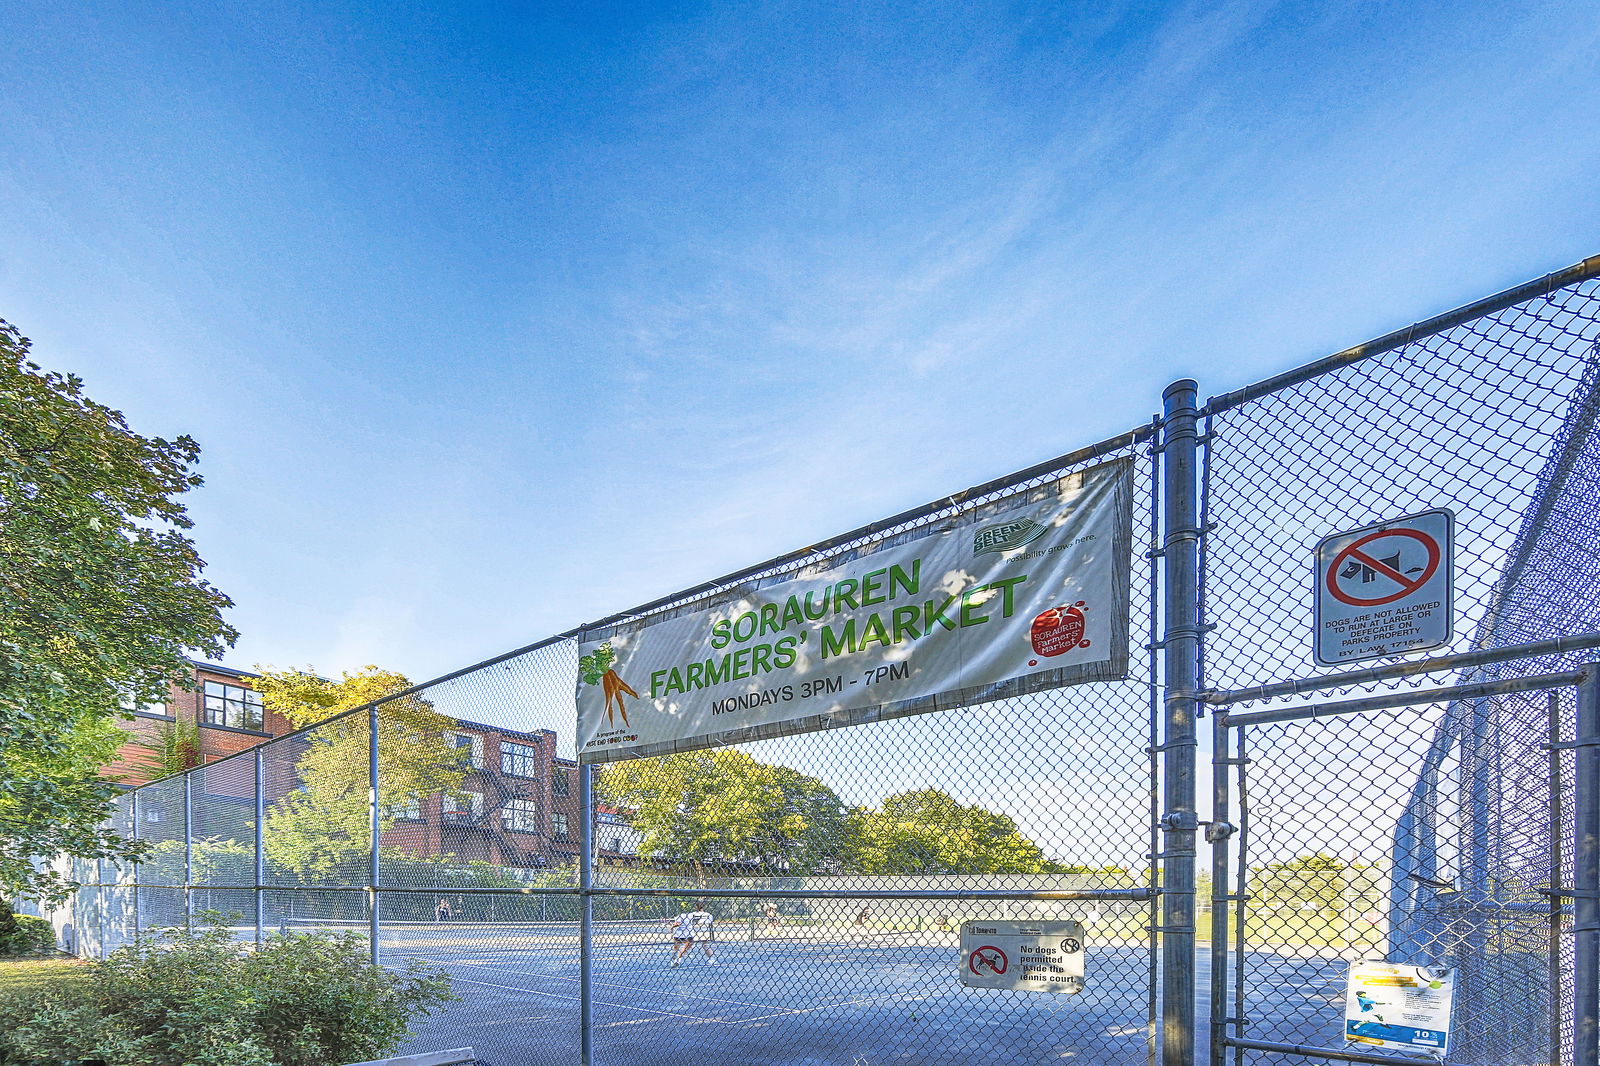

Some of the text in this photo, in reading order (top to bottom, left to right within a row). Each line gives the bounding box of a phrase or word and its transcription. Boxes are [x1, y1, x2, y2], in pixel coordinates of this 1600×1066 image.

[974, 523, 1022, 544] GREEN
[1075, 534, 1097, 545] here.
[973, 534, 1010, 553] BELT
[711, 558, 921, 650] SORAUREN
[1325, 601, 1441, 629] DOGS ARE NOT ALLOWED
[1334, 610, 1431, 634] TO RUN AT LARGE OR
[650, 574, 1028, 699] FARMERS' MARKET
[1034, 620, 1082, 642] SORAUREN
[1341, 626, 1421, 647] PARKS PROPERTY
[1350, 621, 1413, 638] DEFECATE ON
[1041, 637, 1076, 654] Market
[1339, 649, 1354, 657] BY
[1359, 644, 1385, 654] LAW
[712, 685, 794, 716] MONDAYS
[800, 675, 843, 699] 3PM
[864, 660, 910, 686] 7PM
[1020, 945, 1057, 956] No dogs
[1020, 955, 1063, 966] permitted
[1021, 964, 1064, 973] nside the
[1049, 975, 1077, 983] court.
[1413, 1030, 1430, 1038] 10
